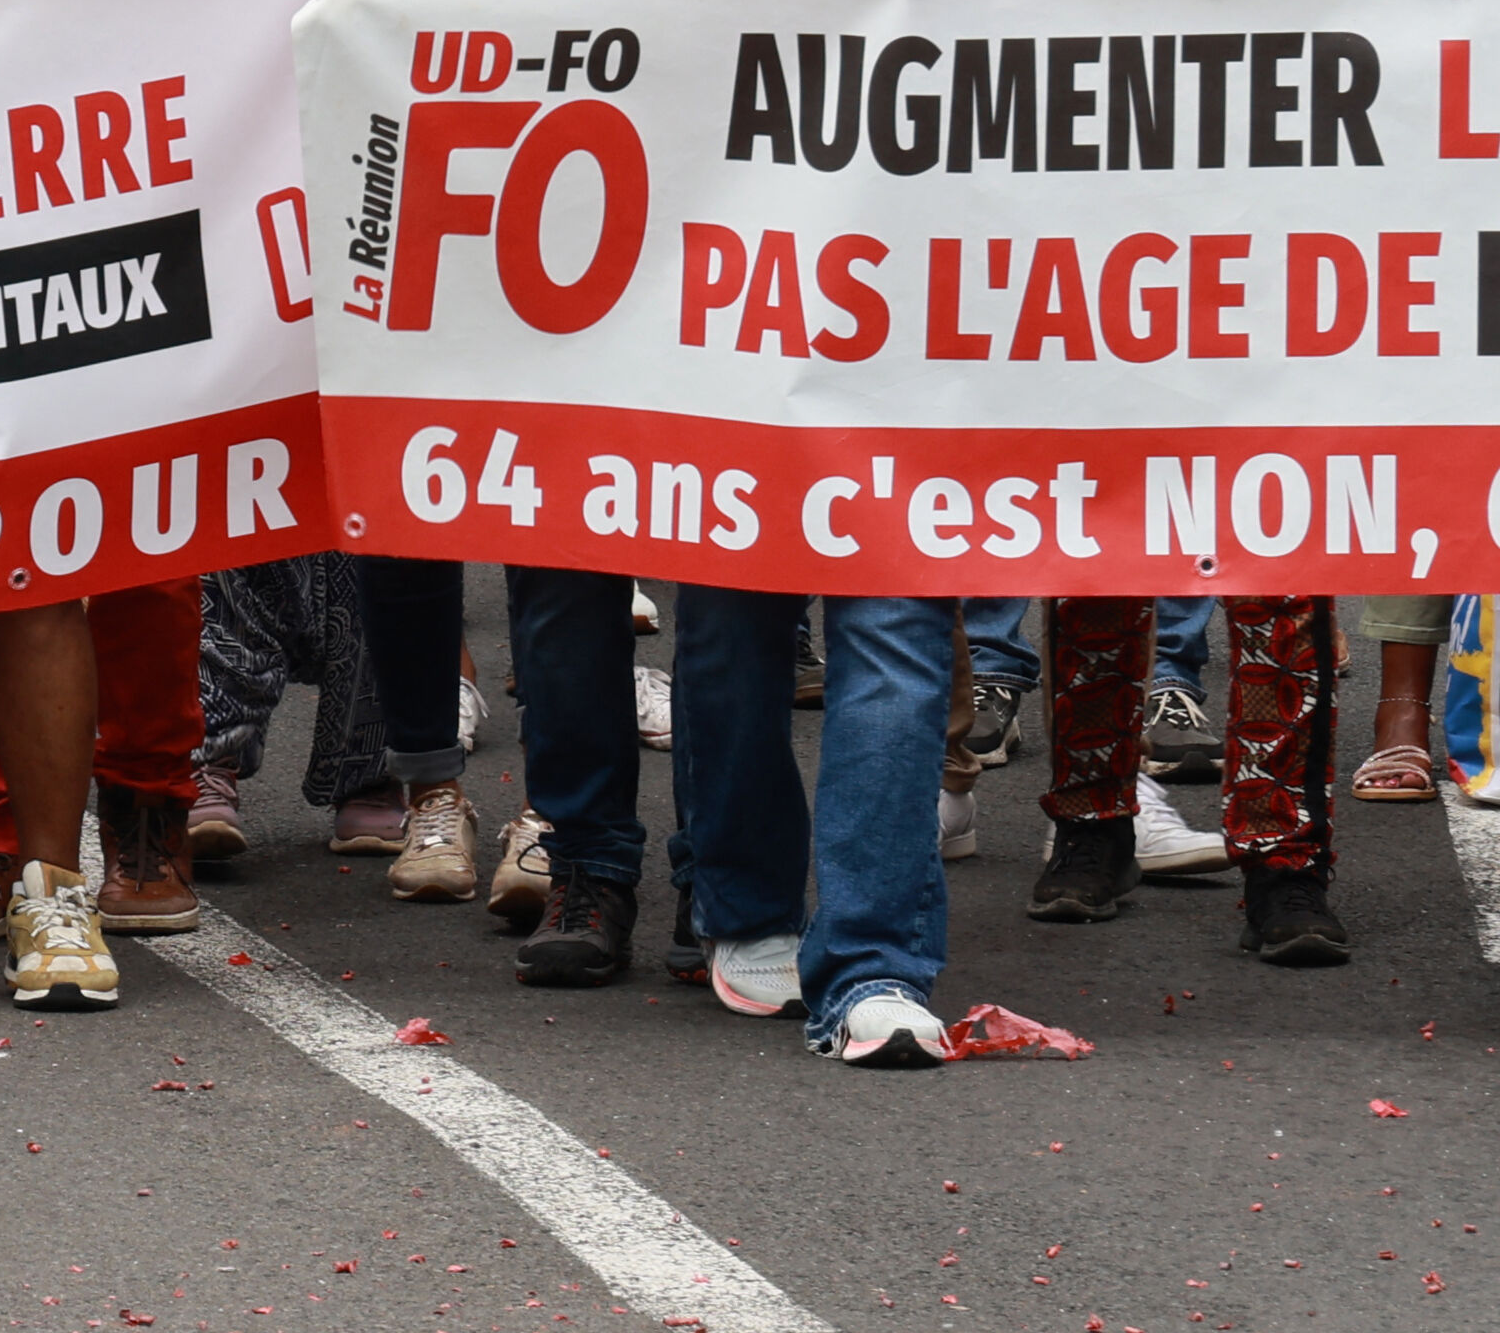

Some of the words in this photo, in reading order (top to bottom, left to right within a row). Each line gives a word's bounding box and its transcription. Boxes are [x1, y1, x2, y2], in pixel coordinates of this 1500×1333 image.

[410, 27, 641, 95] UD-FO
[725, 31, 1385, 176] AUGMENTER
[348, 113, 401, 272] Réunion
[386, 99, 650, 335] FO
[343, 277, 385, 324] La
[679, 222, 890, 364] PAS
[925, 232, 1252, 364] L'AGE
[1286, 232, 1443, 358] DE
[402, 424, 543, 528] 64
[582, 453, 761, 552] ans
[801, 455, 1101, 559] c'est
[1145, 452, 1440, 580] NON,
